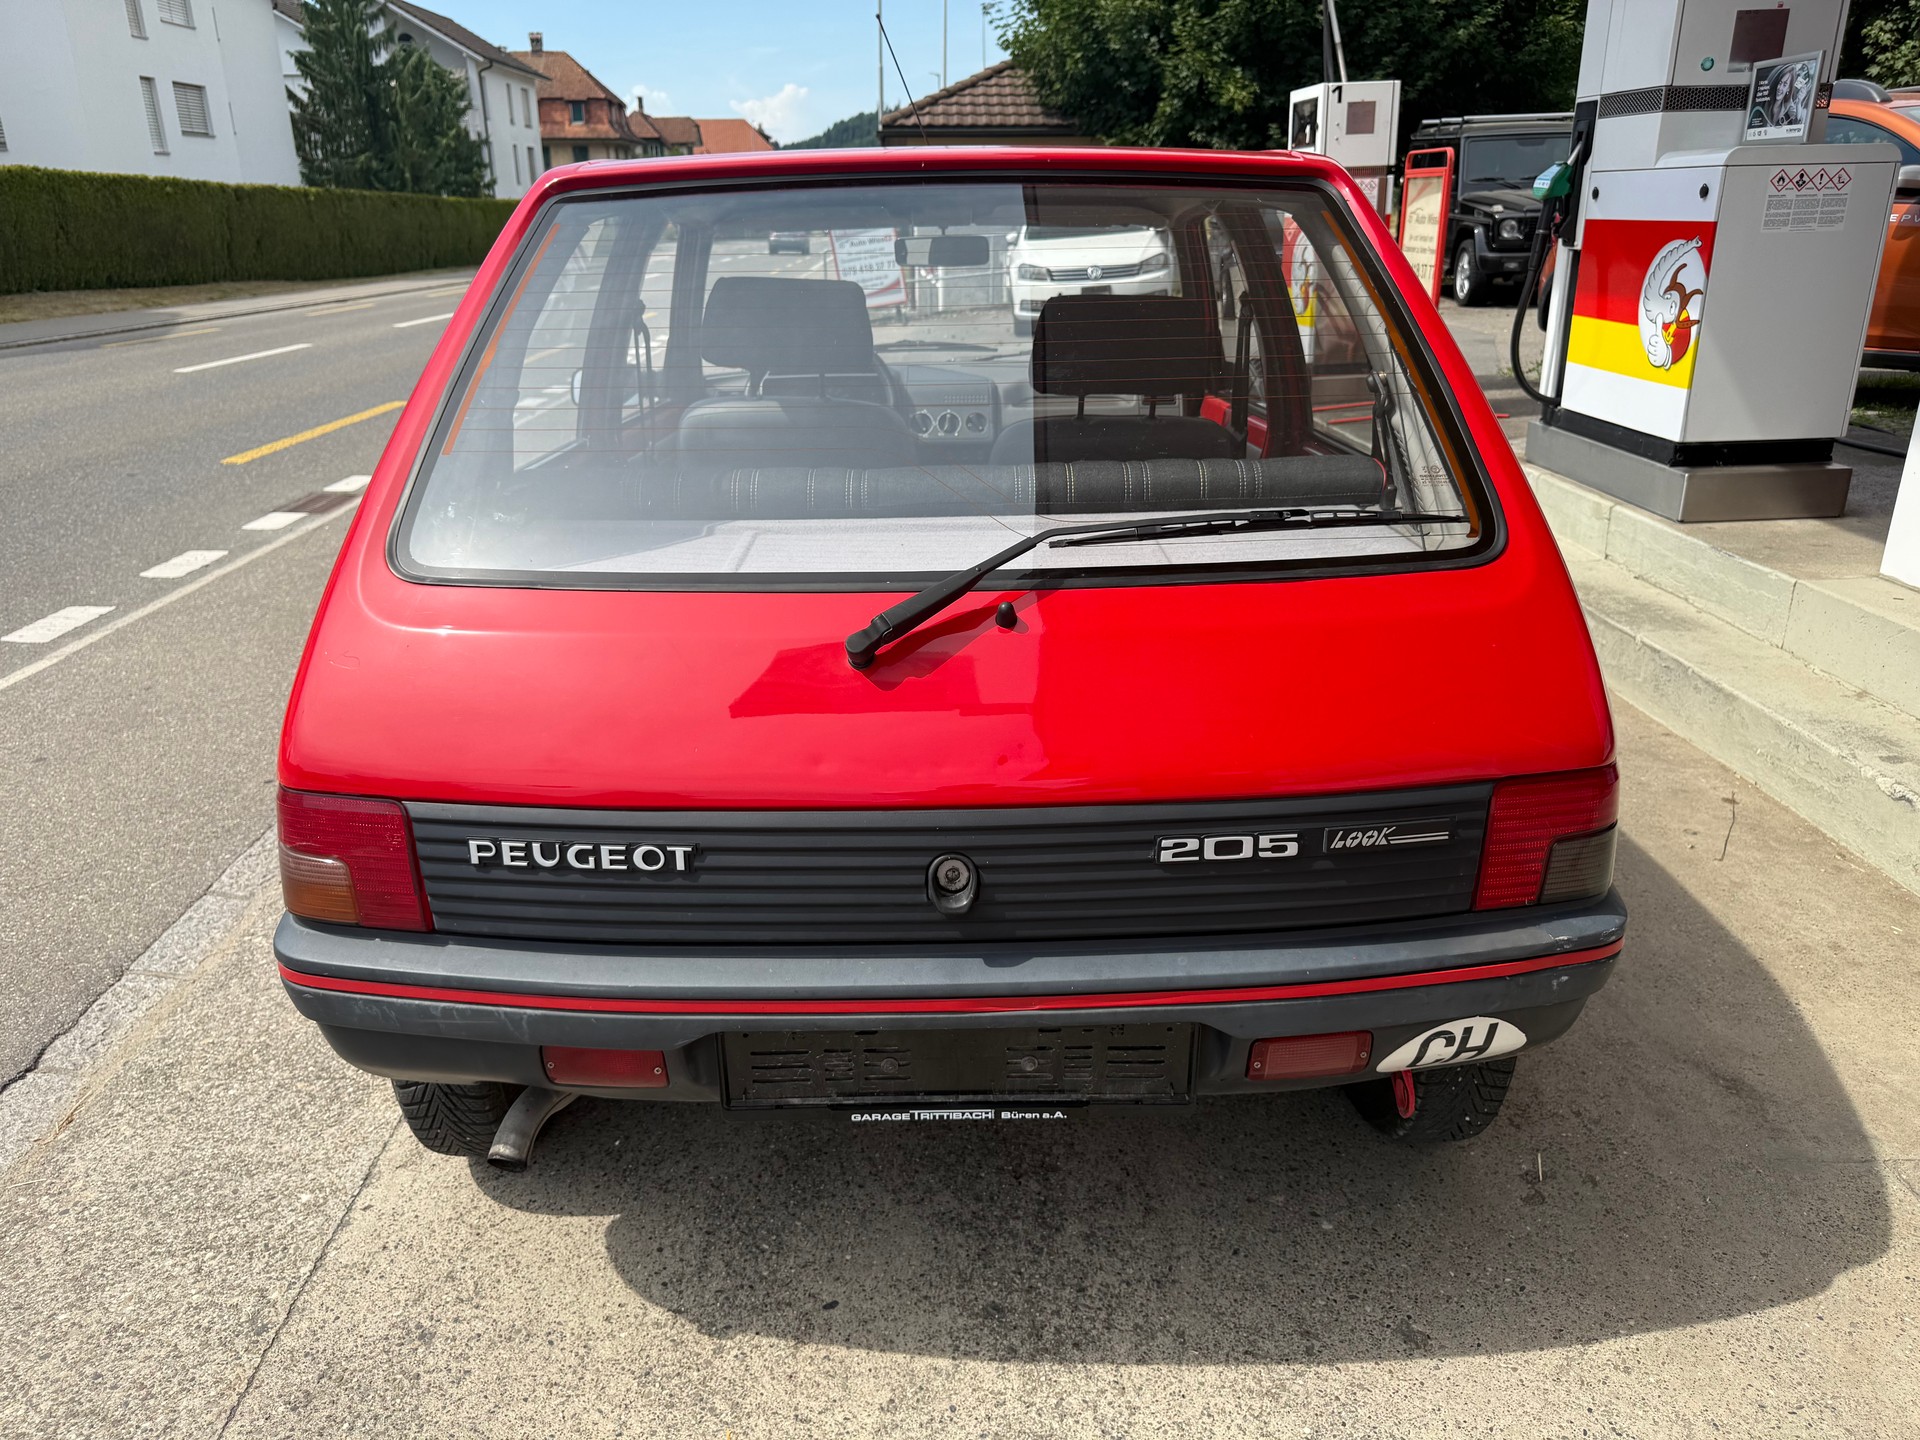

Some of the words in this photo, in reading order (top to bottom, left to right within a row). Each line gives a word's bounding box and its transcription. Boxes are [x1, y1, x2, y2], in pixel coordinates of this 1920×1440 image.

[1332, 85, 1343, 104] 1
[1158, 832, 1300, 863] 205
[1329, 826, 1396, 849] LOOK
[467, 838, 694, 871] PEUGEOT
[1405, 1021, 1500, 1069] CH
[850, 1112, 911, 1122] GARAGE
[1001, 1110, 1041, 1120] Büren
